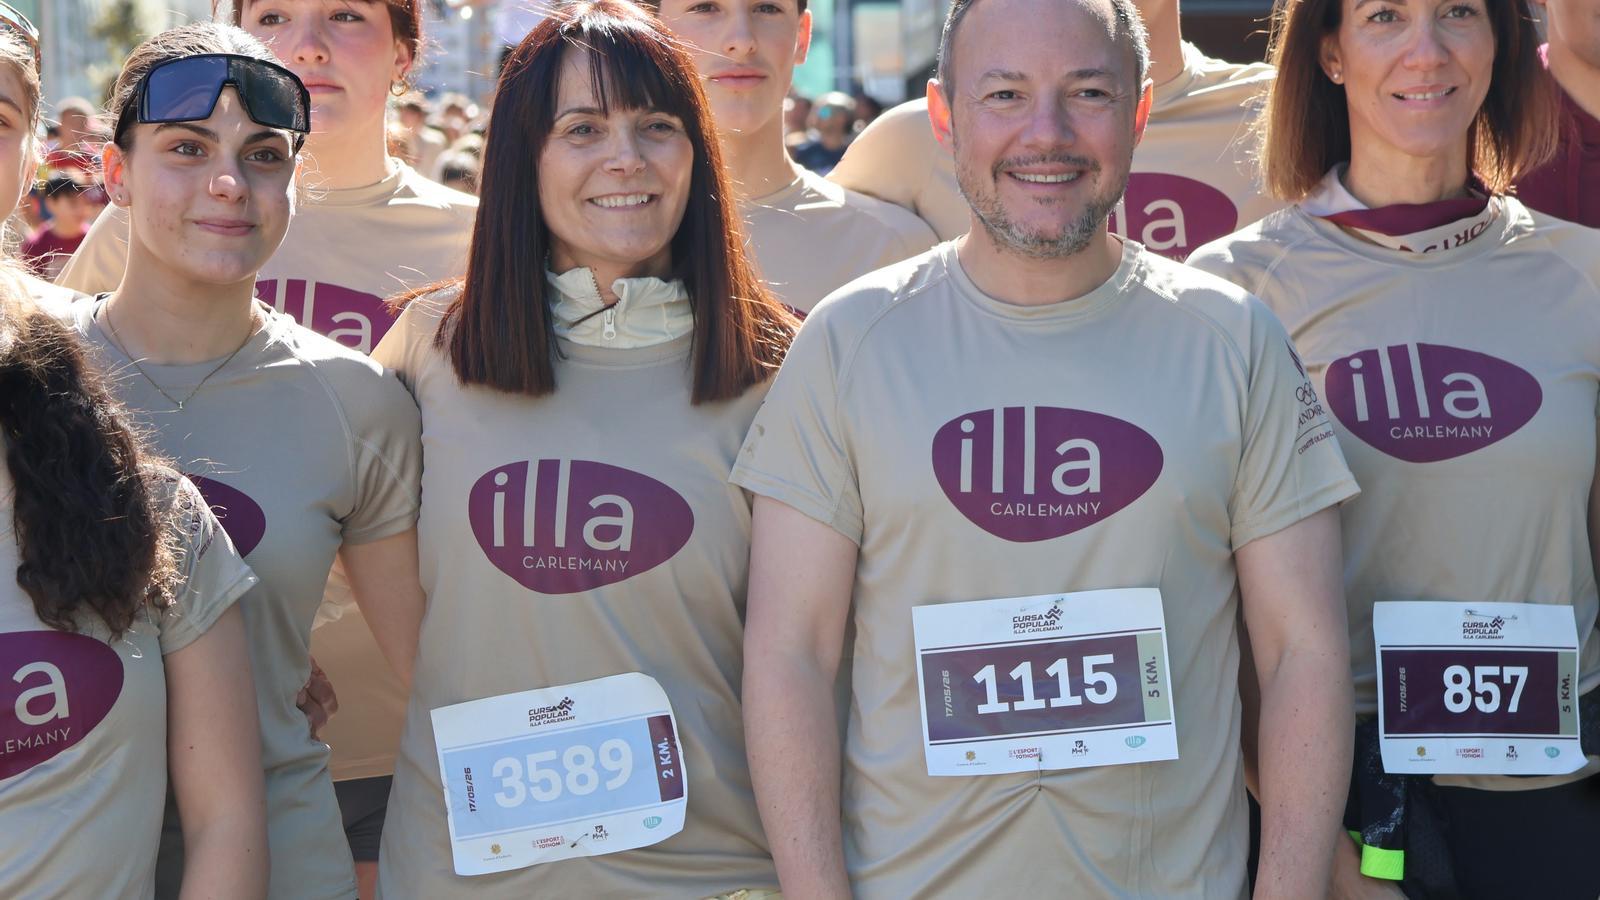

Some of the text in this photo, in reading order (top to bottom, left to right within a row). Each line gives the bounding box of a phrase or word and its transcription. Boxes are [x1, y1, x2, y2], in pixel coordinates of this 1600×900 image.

[1348, 343, 1492, 422] illa
[960, 405, 1101, 496] illa
[1390, 425, 1493, 439] CARLEMANY
[493, 459, 634, 552] illa
[990, 502, 1101, 517] CARLEMANY
[522, 555, 629, 573] CARLEMANY
[1012, 614, 1044, 623] CURSA
[1013, 619, 1056, 630] POPULAR
[972, 653, 1118, 715] 1115
[1145, 656, 1160, 698] 5 KM.
[1443, 664, 1529, 714] 857
[1561, 673, 1571, 713] 5 KM.
[528, 705, 558, 716] CURSA
[529, 710, 569, 722] POPULAR
[491, 738, 633, 808] 3589
[660, 737, 674, 778] 2 KM.
[463, 766, 477, 812] 17/05/26
